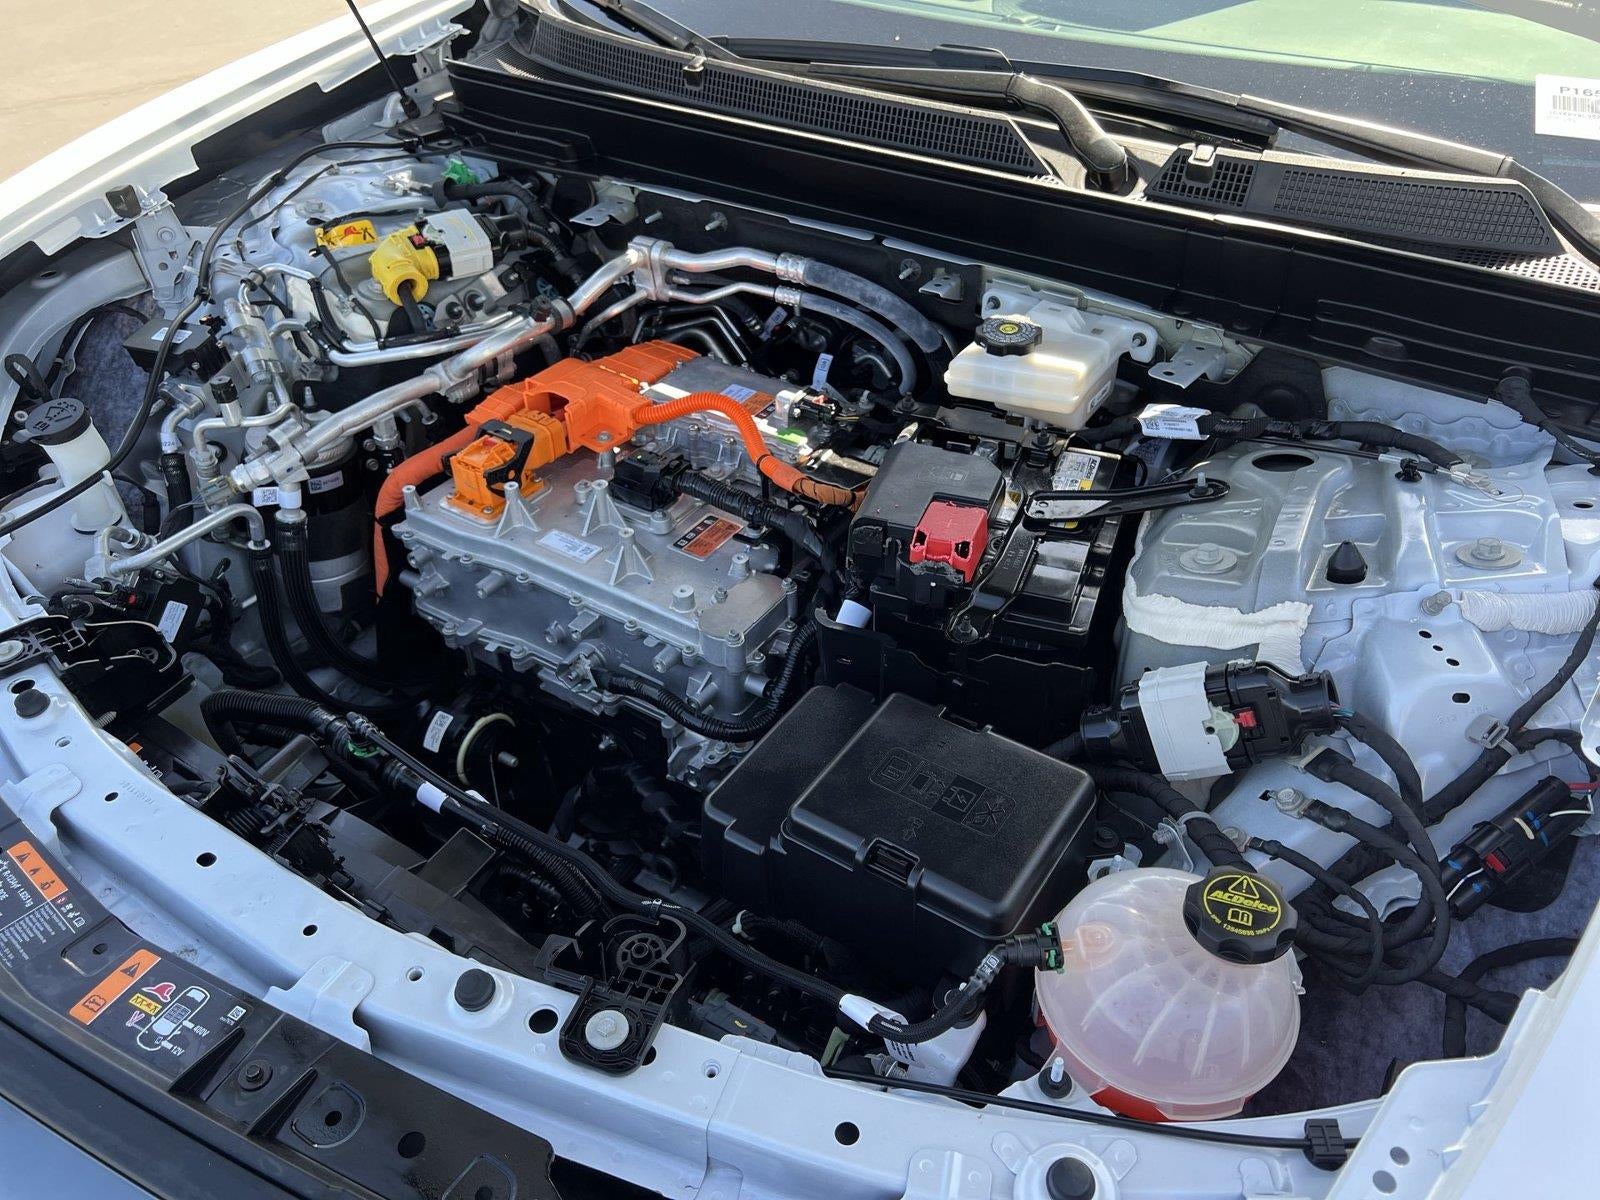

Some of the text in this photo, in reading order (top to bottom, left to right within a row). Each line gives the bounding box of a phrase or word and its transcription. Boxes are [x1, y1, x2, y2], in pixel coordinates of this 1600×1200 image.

[1209, 890, 1278, 913] ACDelco
[193, 1024, 210, 1037] 400V
[170, 1045, 185, 1057] 12V
